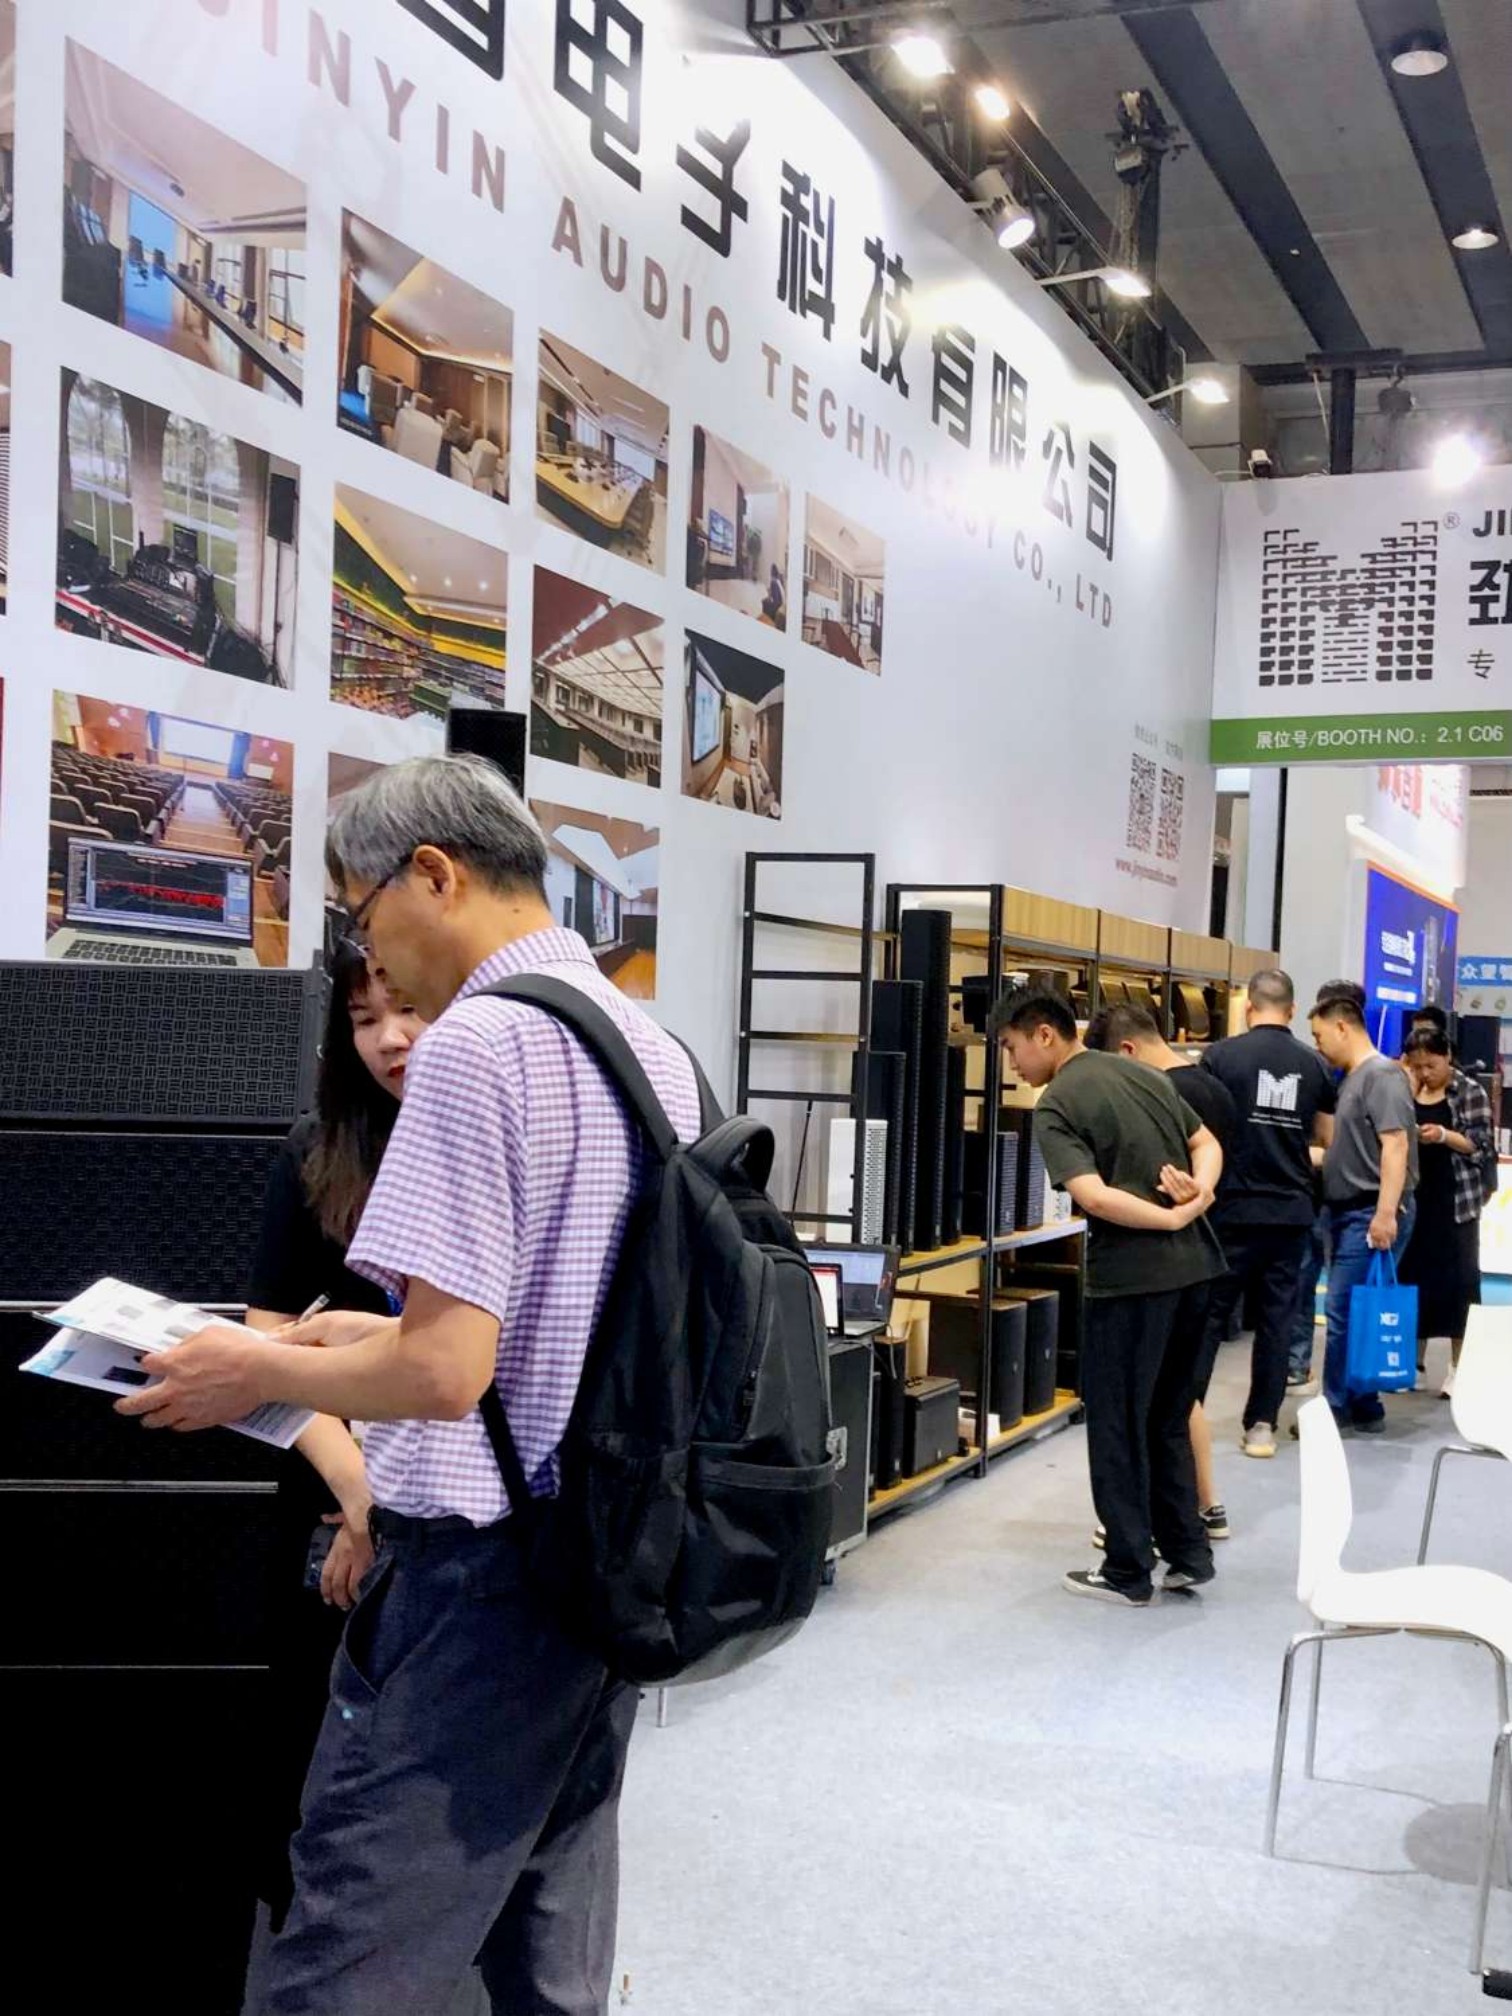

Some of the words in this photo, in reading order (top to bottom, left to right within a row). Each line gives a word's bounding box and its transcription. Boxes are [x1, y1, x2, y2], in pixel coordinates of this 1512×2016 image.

[203, 0, 505, 214] INYIN
[552, 196, 730, 363] AUDIO
[1075, 572, 1113, 629] LTD
[1473, 509, 1512, 538] JI
[1256, 729, 1381, 750] 展位号/BOOTH
[1437, 726, 1463, 744] 2.1
[1468, 726, 1503, 743] C06
